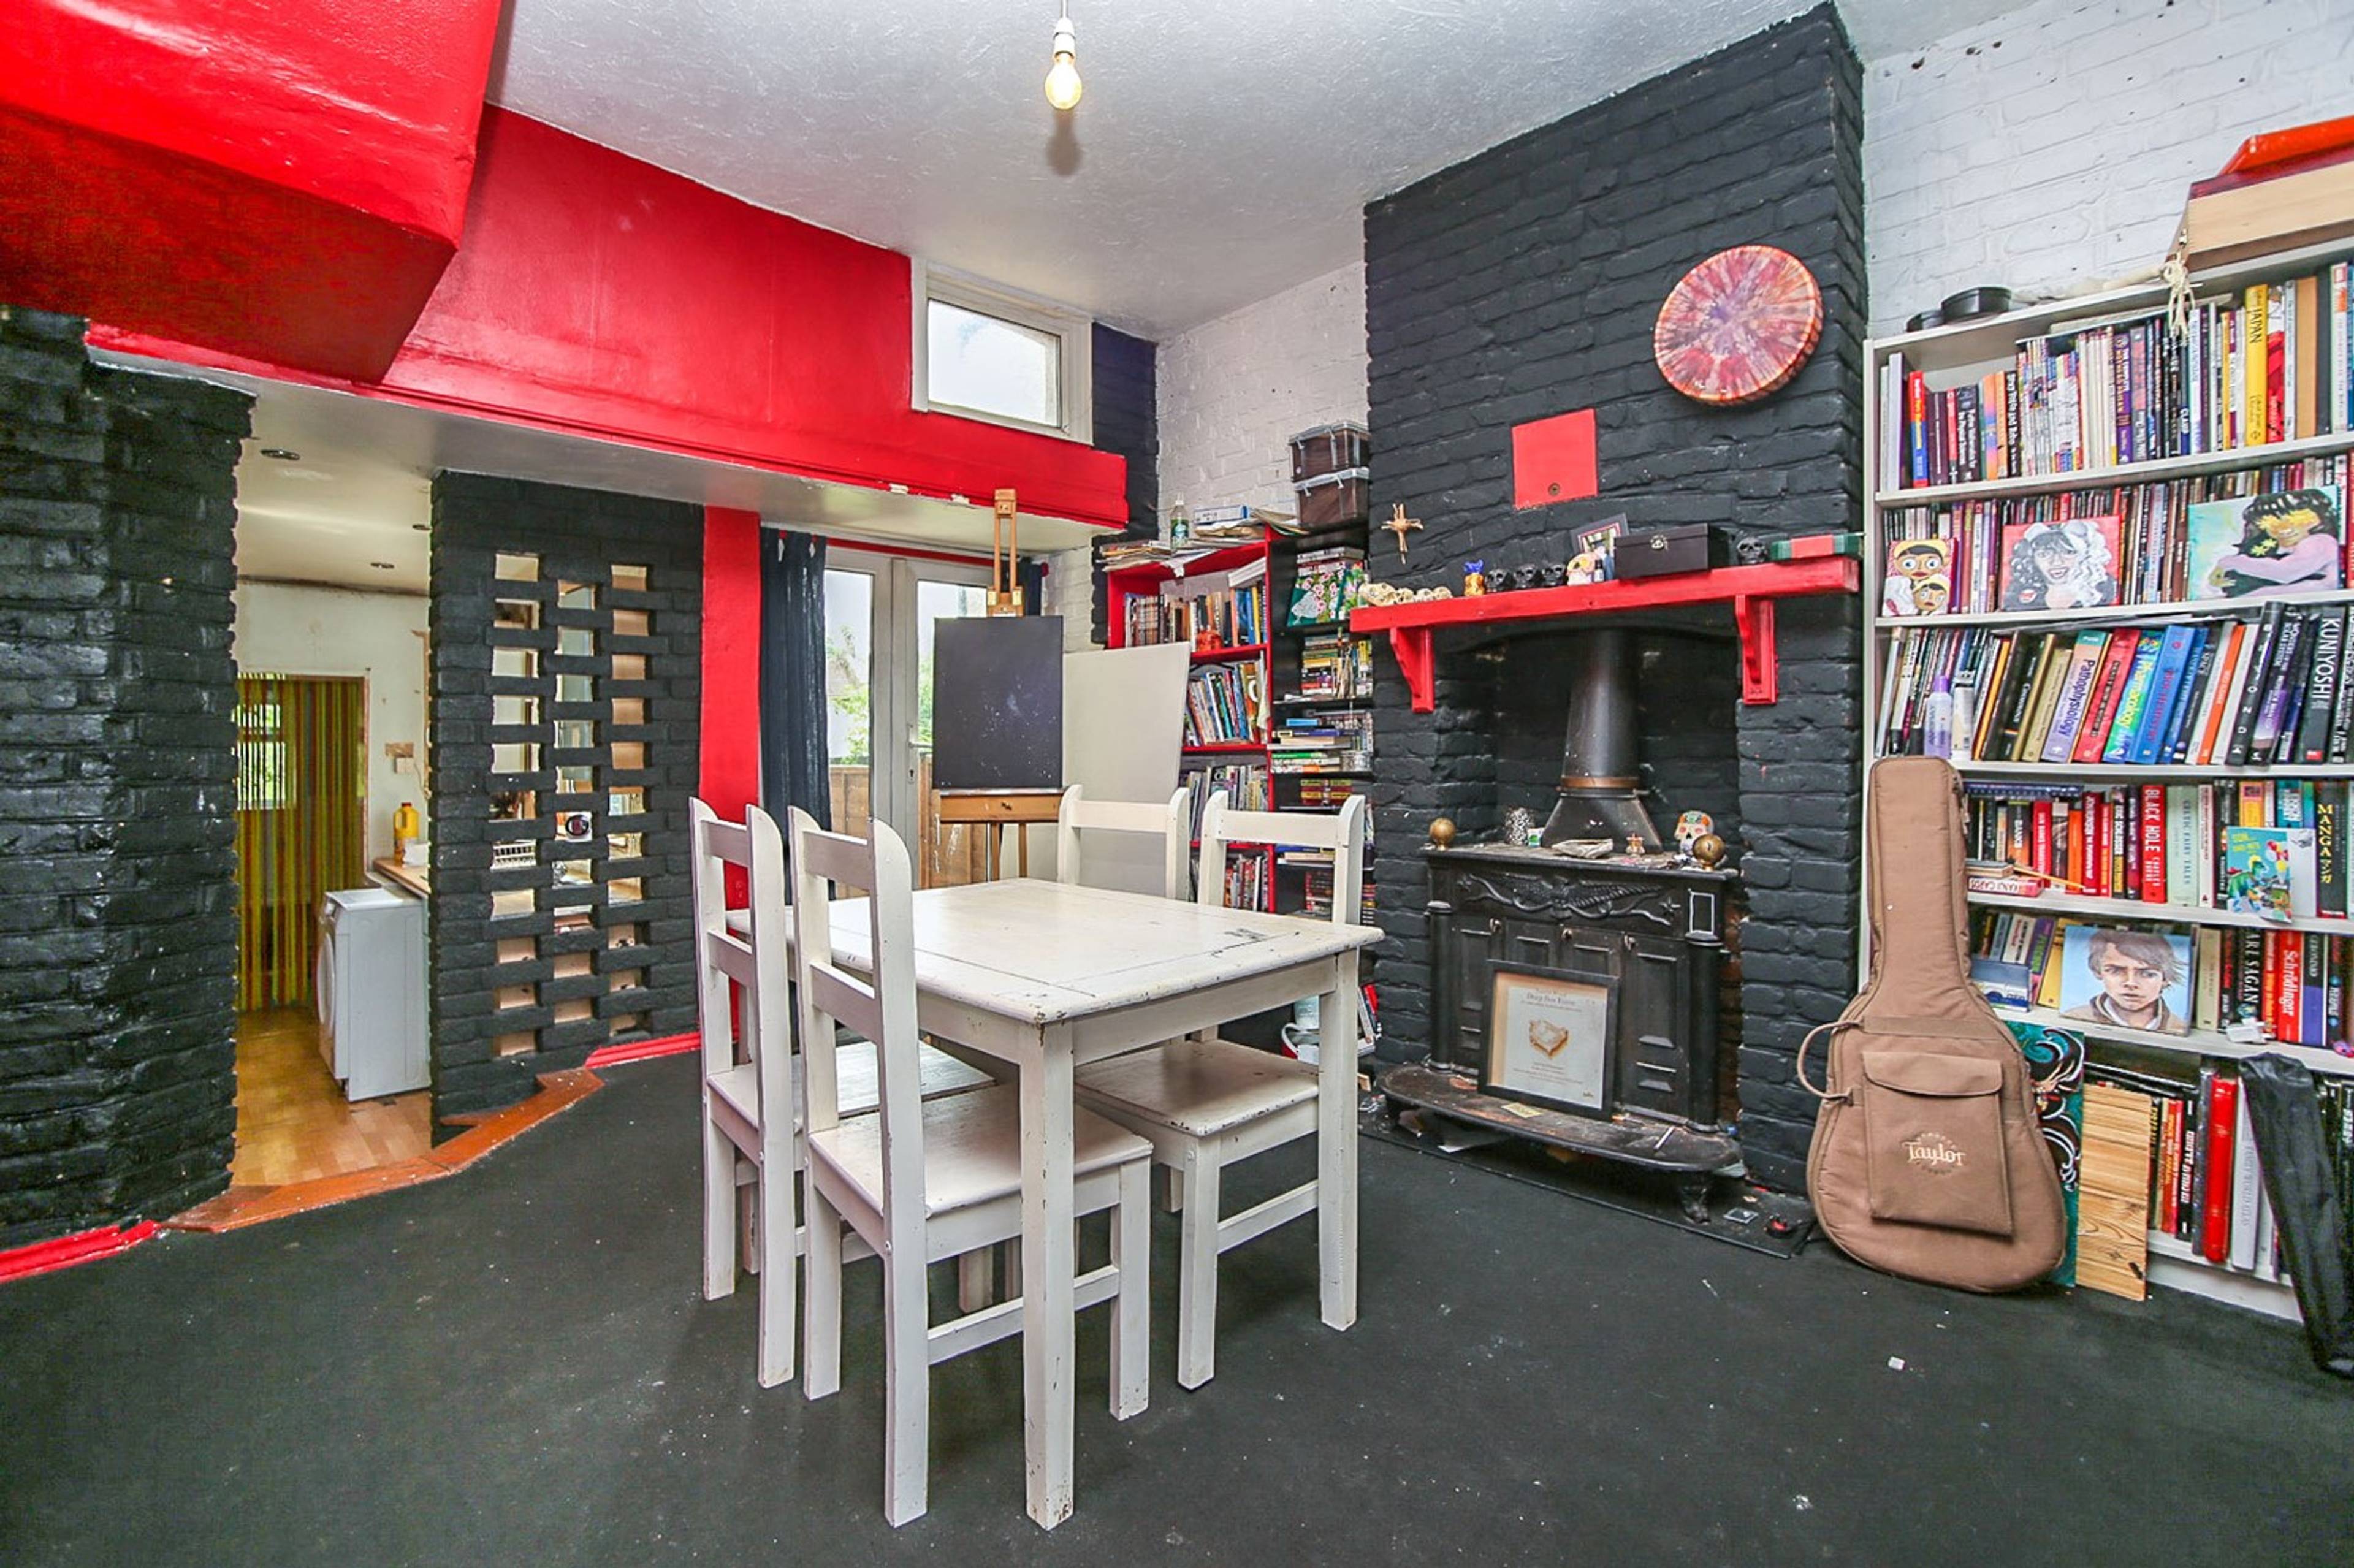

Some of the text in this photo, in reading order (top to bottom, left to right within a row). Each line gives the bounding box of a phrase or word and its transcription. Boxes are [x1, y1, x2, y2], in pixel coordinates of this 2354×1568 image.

[2246, 309, 2262, 344] JAPAN
[2312, 617, 2341, 699] KUNIYOSHI
[2059, 659, 2095, 737] Pathophysiology
[2144, 788, 2161, 853] BLACK HOLE
[2317, 804, 2333, 857] MANGA
[2244, 961, 2260, 1003] SAGAN
[2277, 950, 2299, 1017] Schrödinger
[1902, 1141, 1966, 1166] Taylor
